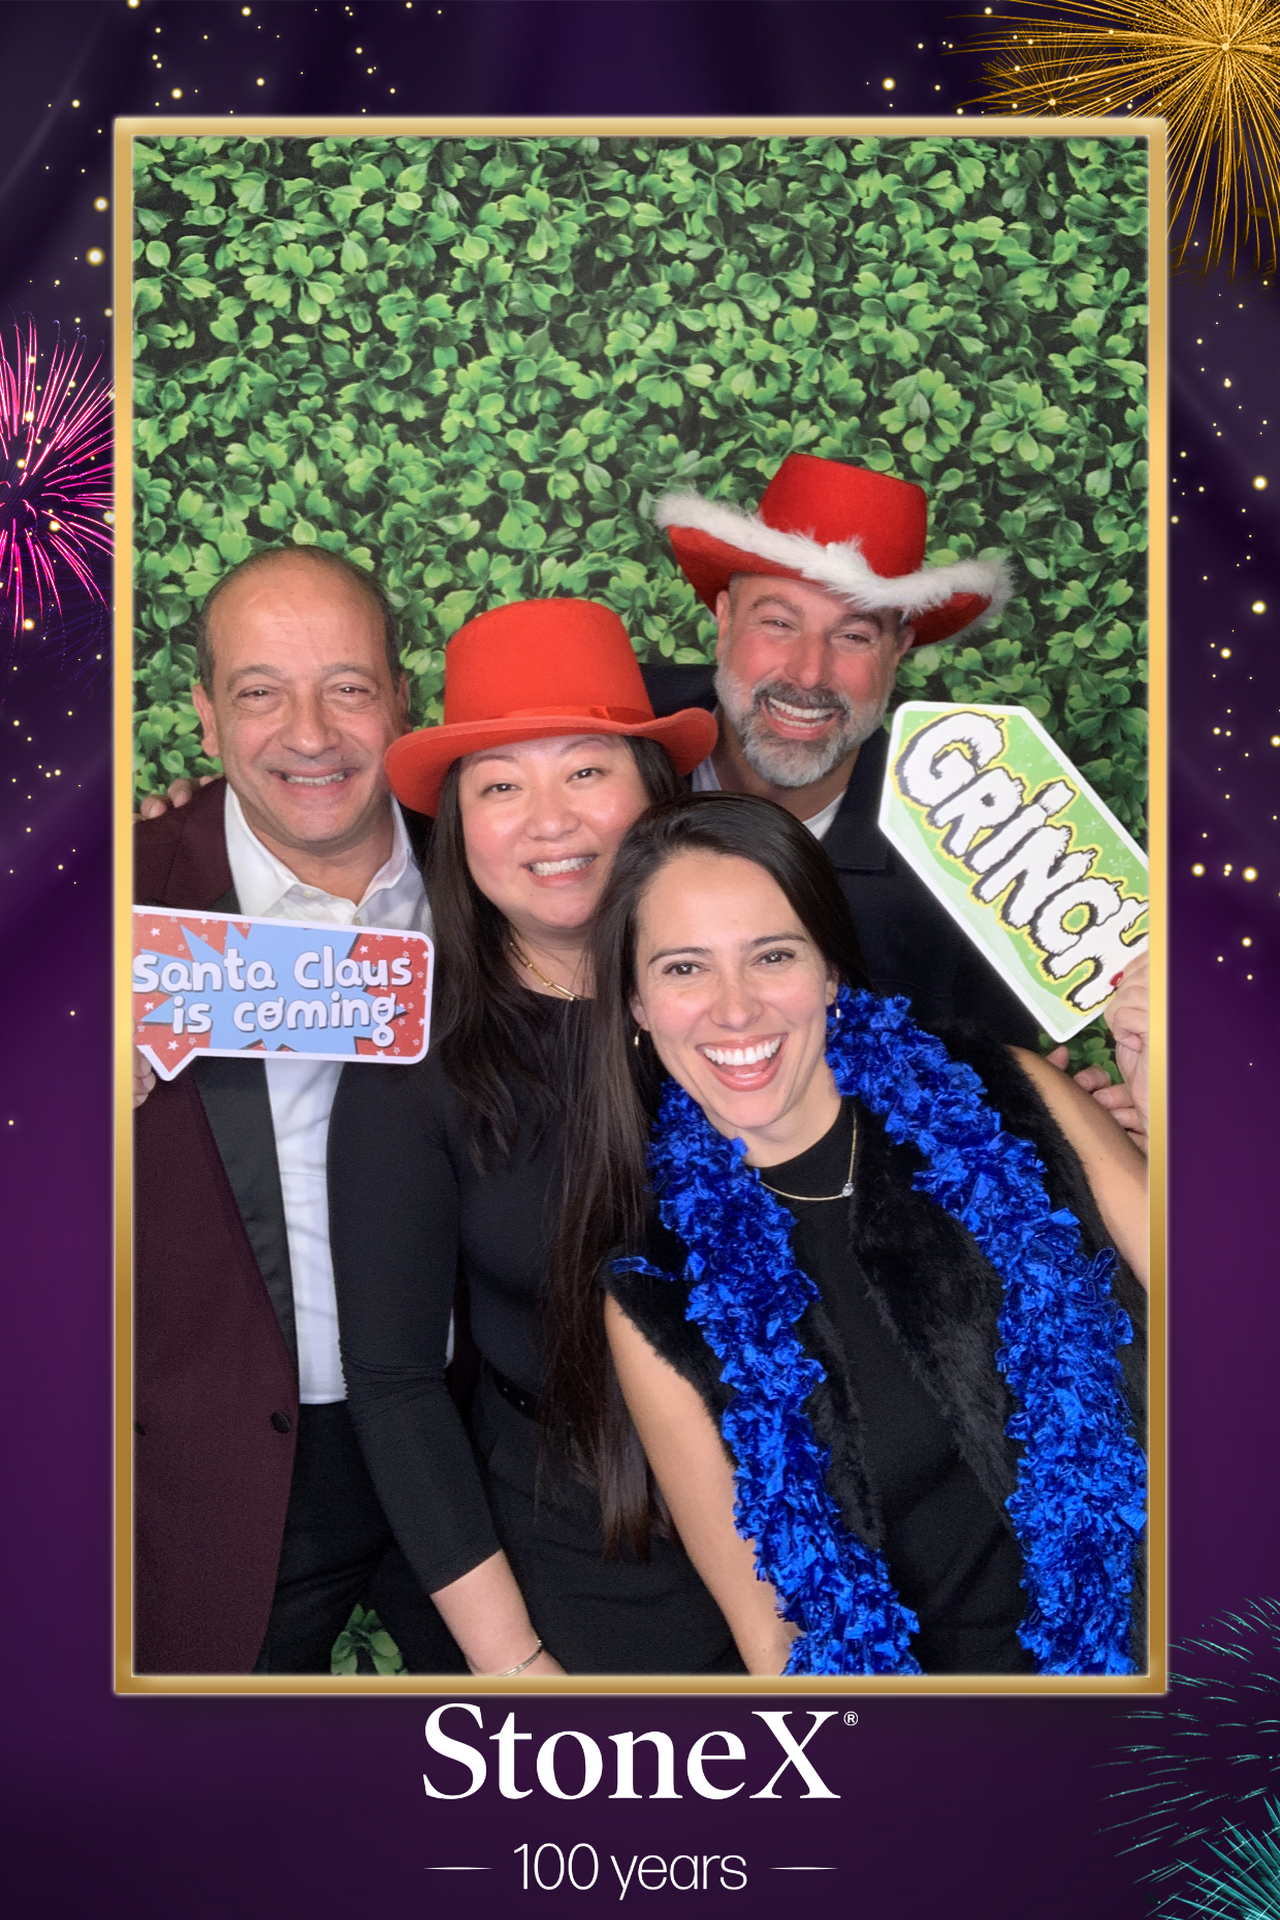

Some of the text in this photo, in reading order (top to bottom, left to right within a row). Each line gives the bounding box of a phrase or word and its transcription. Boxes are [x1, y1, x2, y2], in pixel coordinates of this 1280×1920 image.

[132, 945, 413, 993] Santa Claus
[172, 991, 396, 1047] is coming
